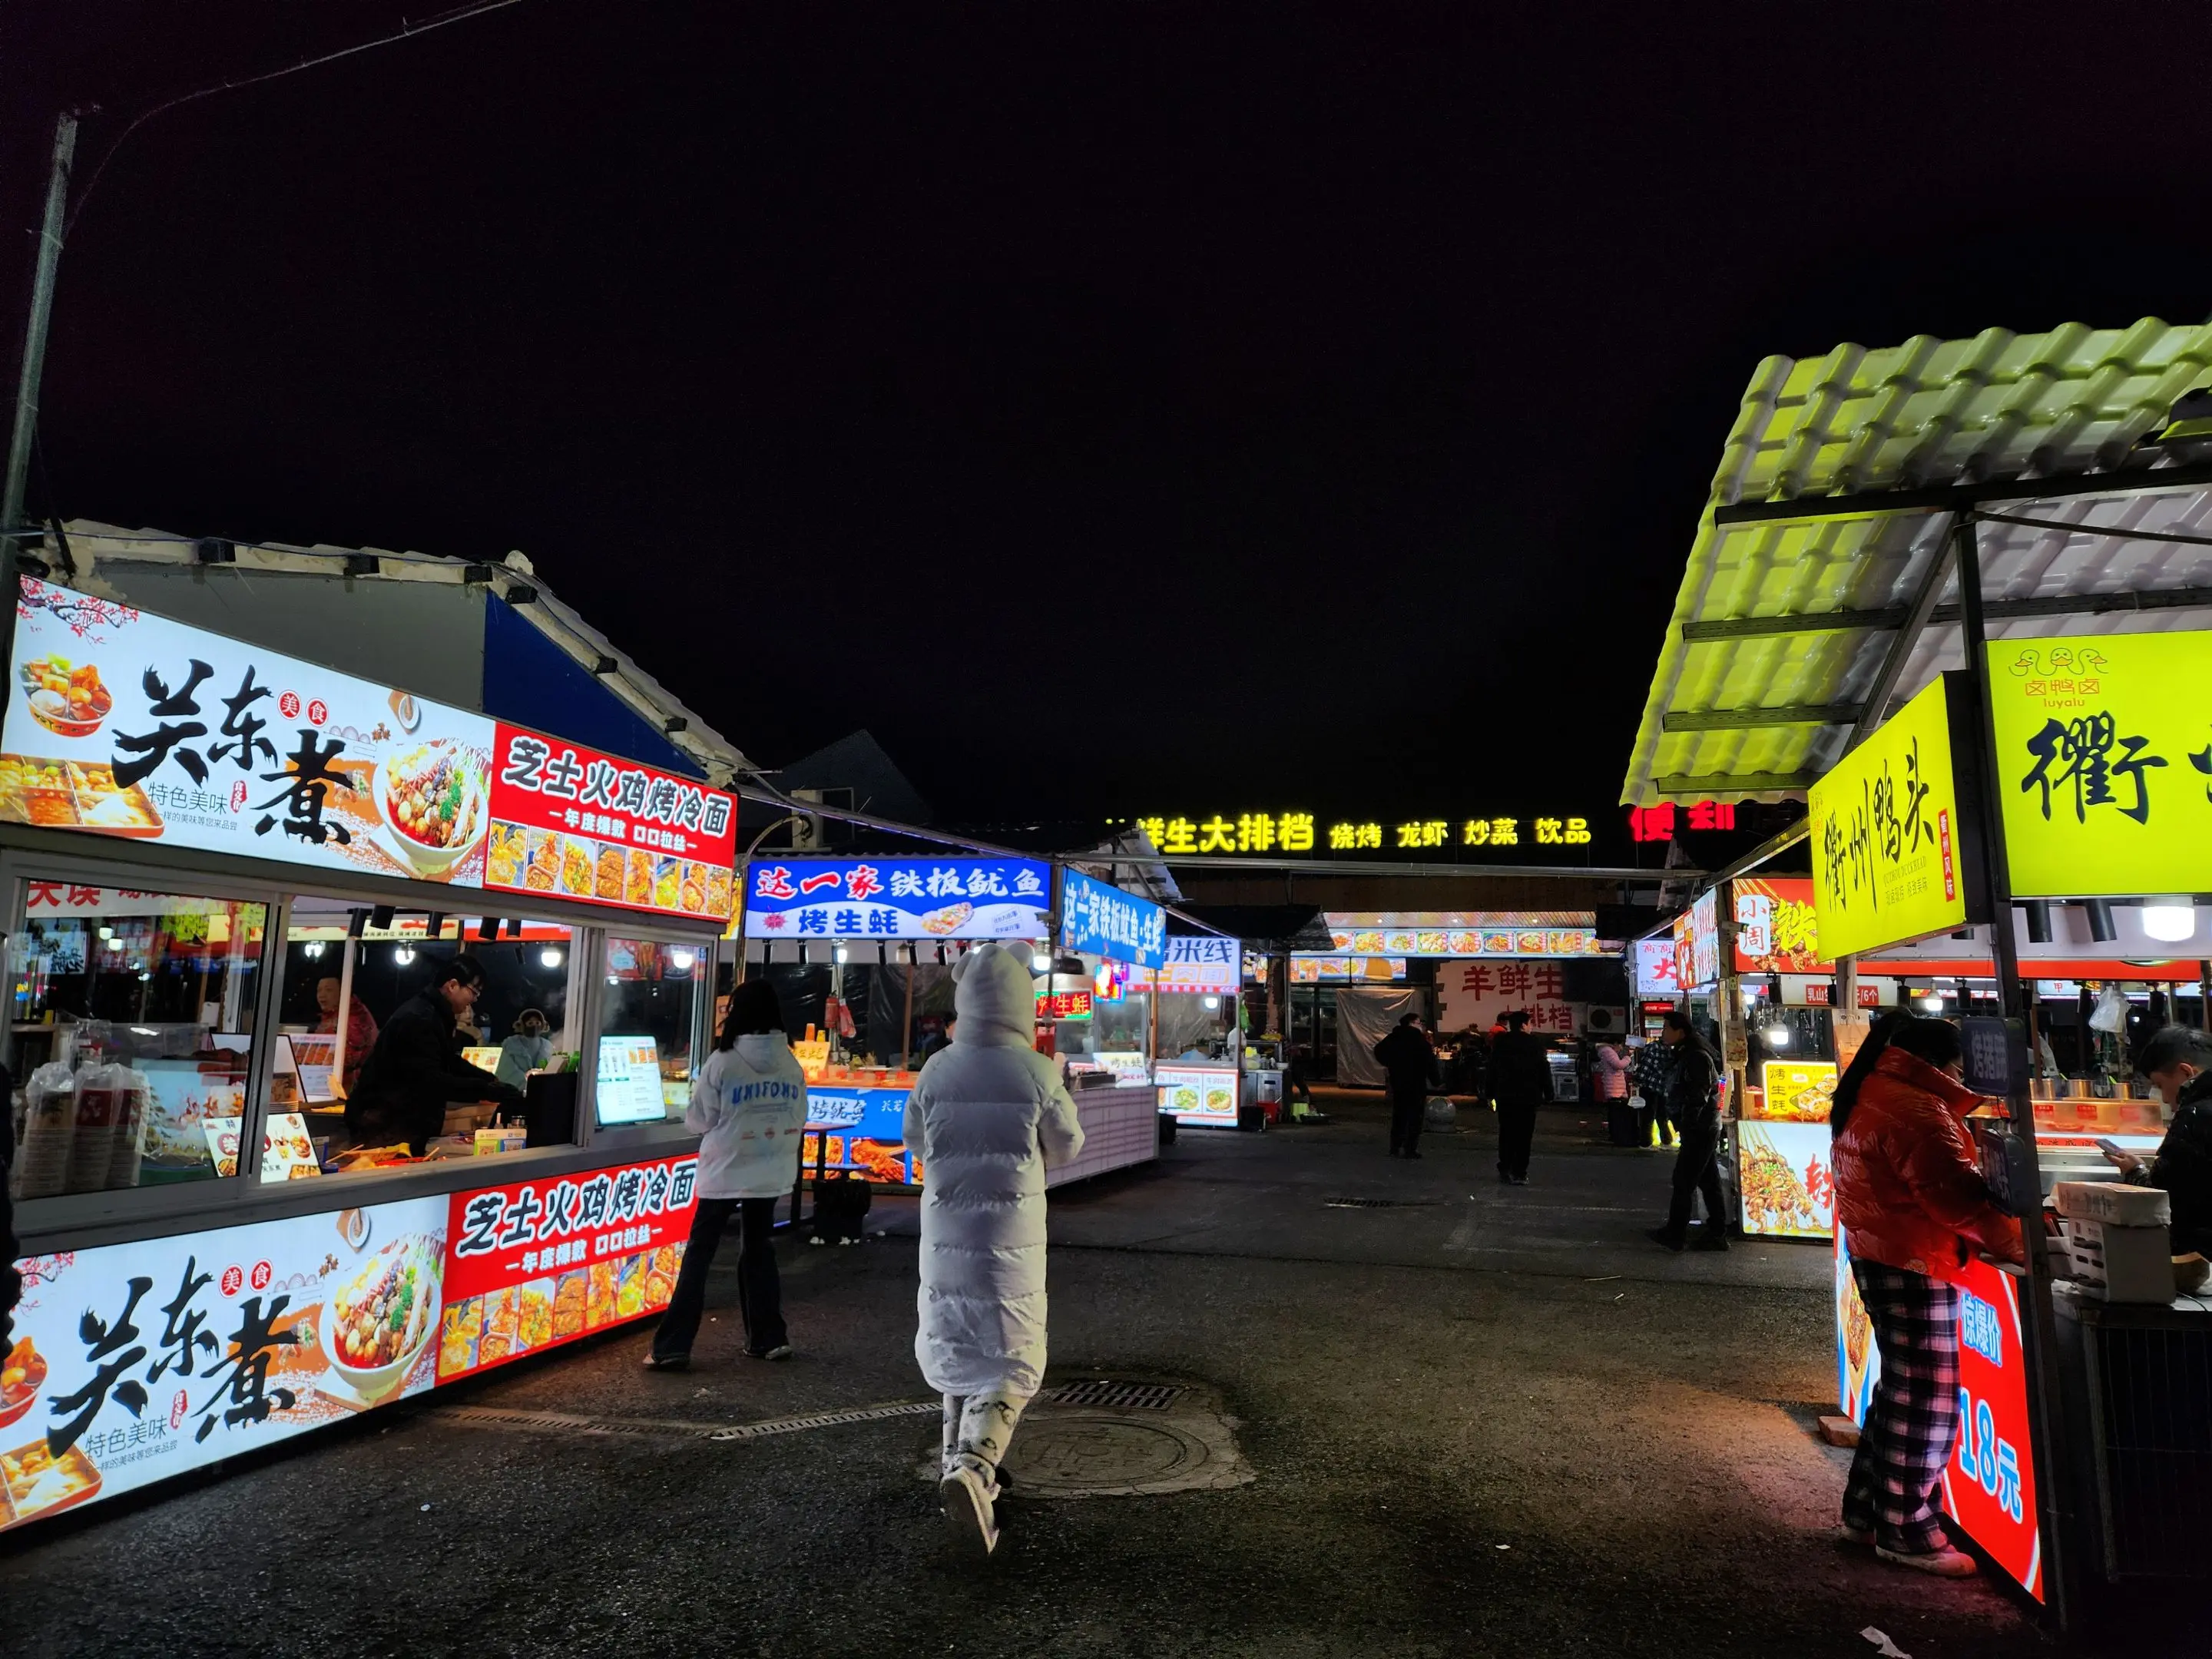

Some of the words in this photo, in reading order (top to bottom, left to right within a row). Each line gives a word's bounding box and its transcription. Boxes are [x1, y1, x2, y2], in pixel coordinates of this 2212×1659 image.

[279, 691, 328, 725] 美食
[2025, 677, 2101, 697] 卤鸭卤
[2044, 697, 2085, 709] luyalu
[111, 658, 356, 846] 关东煮
[2022, 710, 2212, 826] 衢
[147, 781, 228, 815] 特色美味
[500, 735, 731, 837] 芝士火鸡烤冷面
[1330, 823, 1382, 849] 烧烤
[1397, 821, 1448, 848] 龙虾
[1465, 818, 1518, 845] 炒菜
[1536, 817, 1591, 844] 饮品
[799, 909, 898, 935] 烤生蚝
[1740, 899, 1767, 951] 小周
[1462, 963, 1564, 1001] 羊鲜生
[455, 1160, 699, 1258] 芝士火鸡烤冷面
[222, 1260, 270, 1295] 美食
[1962, 1290, 2002, 1367] 惊爆价
[48, 1255, 300, 1459] 关东煮
[85, 1414, 167, 1459] 特色美味
[1960, 1388, 2023, 1524] 18元
